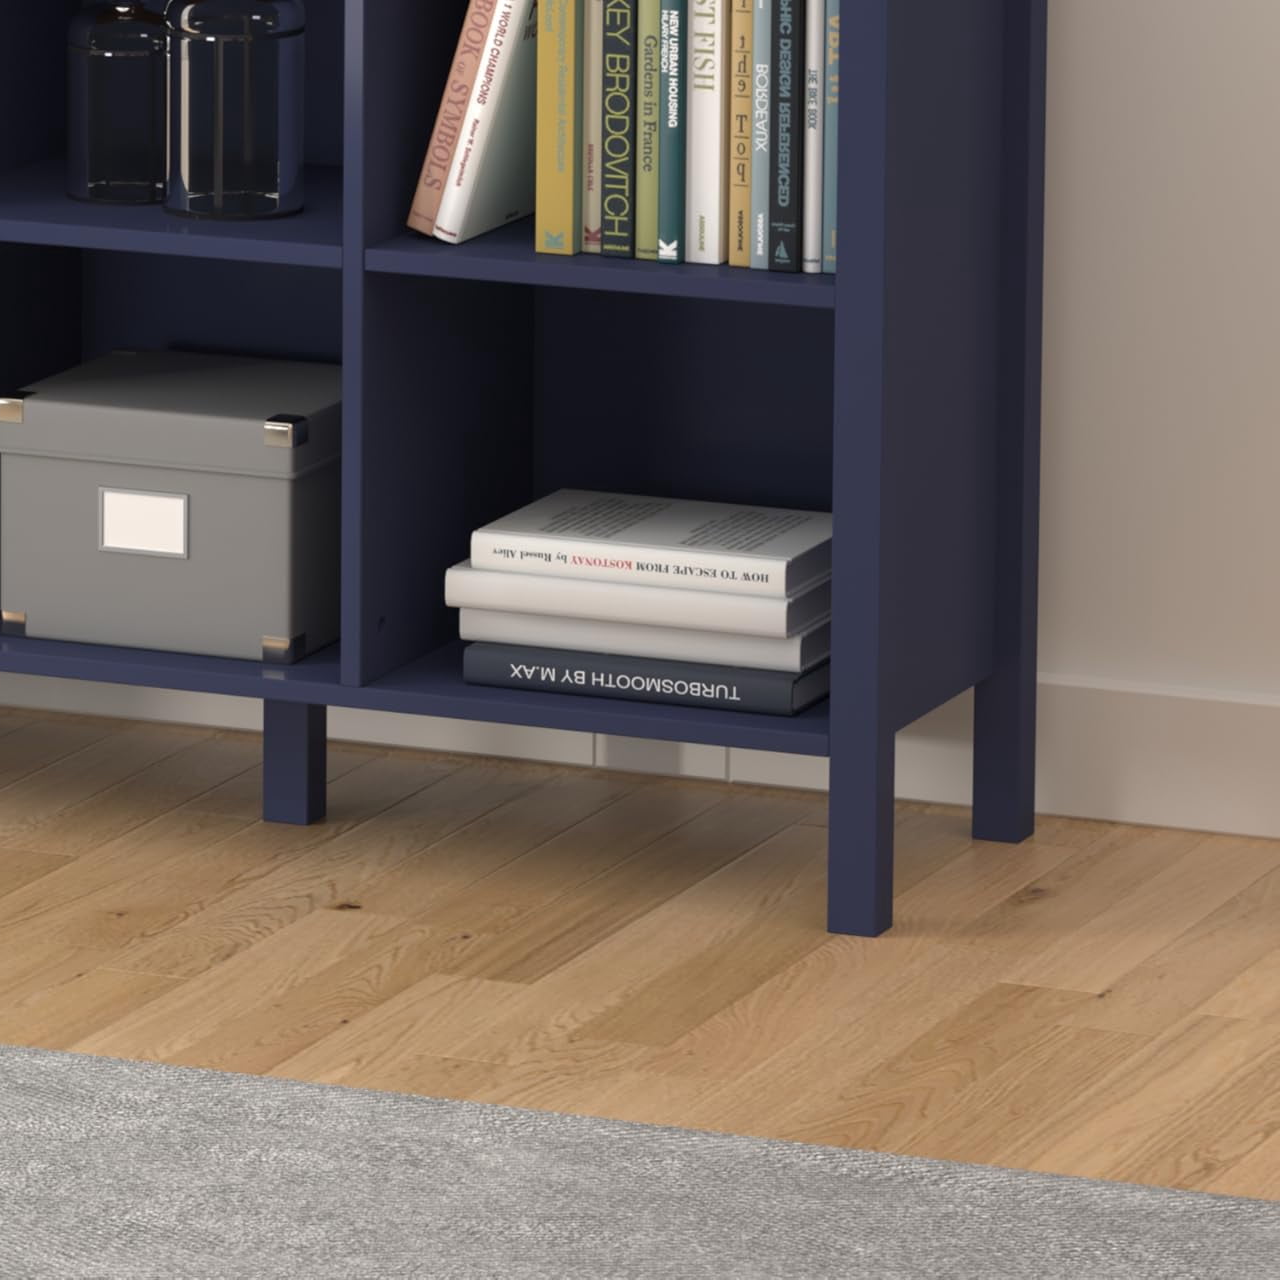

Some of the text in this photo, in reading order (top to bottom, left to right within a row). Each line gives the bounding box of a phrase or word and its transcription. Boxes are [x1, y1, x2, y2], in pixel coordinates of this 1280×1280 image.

[493, 10, 512, 47] WORLD
[476, 47, 501, 106] CHAMPIONS
[668, 10, 679, 129] NEW URBAN HOUSING
[693, 32, 716, 91] FISH
[642, 35, 658, 173] Gardens in France
[424, 80, 470, 191] SYMBOLS
[604, 53, 630, 237] BRODOVITCH
[556, 552, 568, 565] by
[570, 555, 633, 571] KOSTONAY
[635, 561, 669, 574] FROM
[672, 565, 718, 579] ESCAPE
[720, 570, 738, 580] TO
[740, 571, 770, 584] HOW
[509, 662, 741, 701] TURBOSMOOTH BY M.AX
